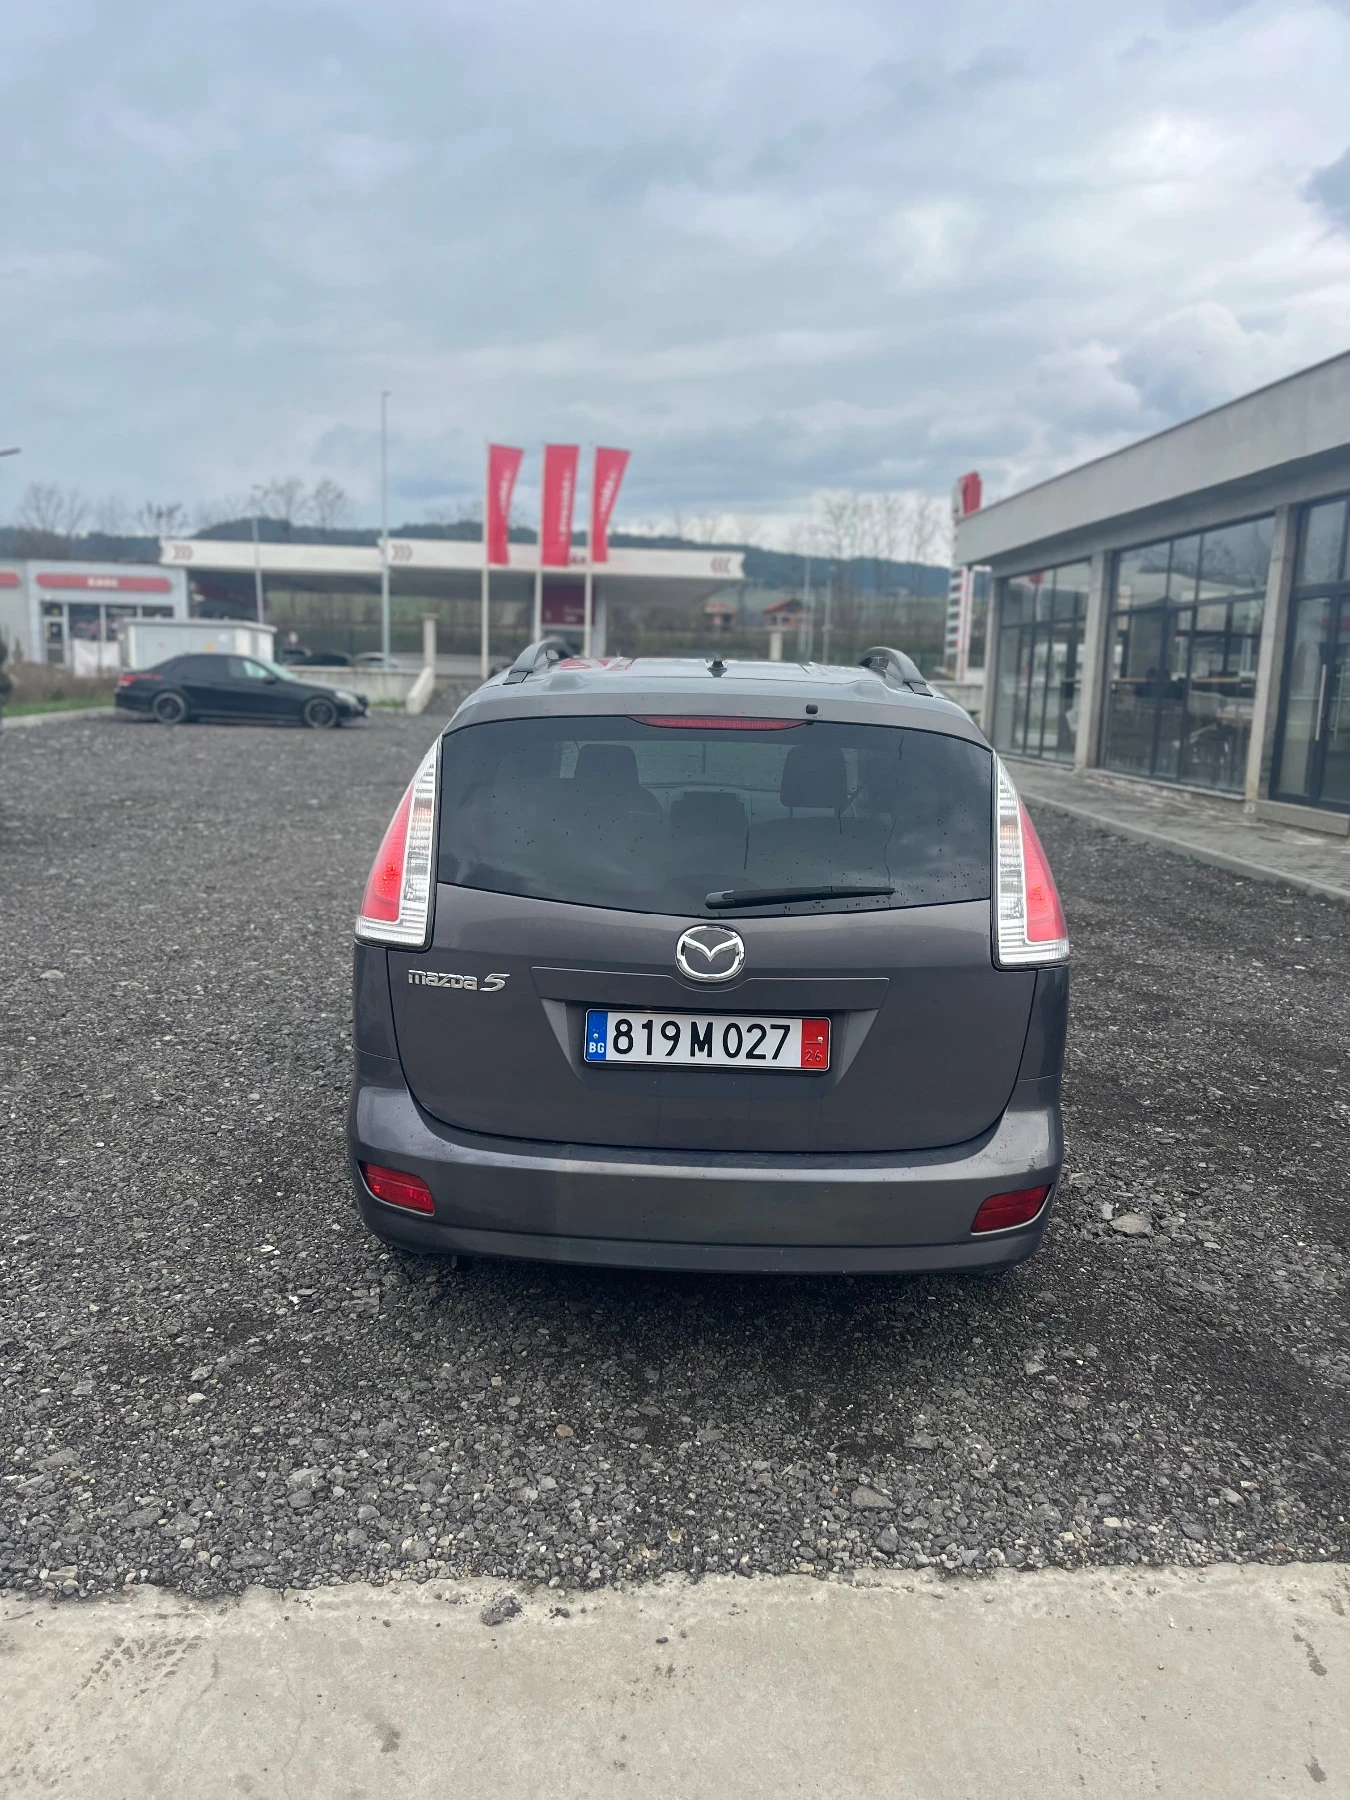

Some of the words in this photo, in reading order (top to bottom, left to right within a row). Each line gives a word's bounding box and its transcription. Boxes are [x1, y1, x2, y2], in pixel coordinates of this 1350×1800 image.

[408, 969, 478, 991] mazda
[480, 973, 511, 992] 5
[588, 1041, 605, 1054] BG
[804, 1049, 823, 1062] 26
